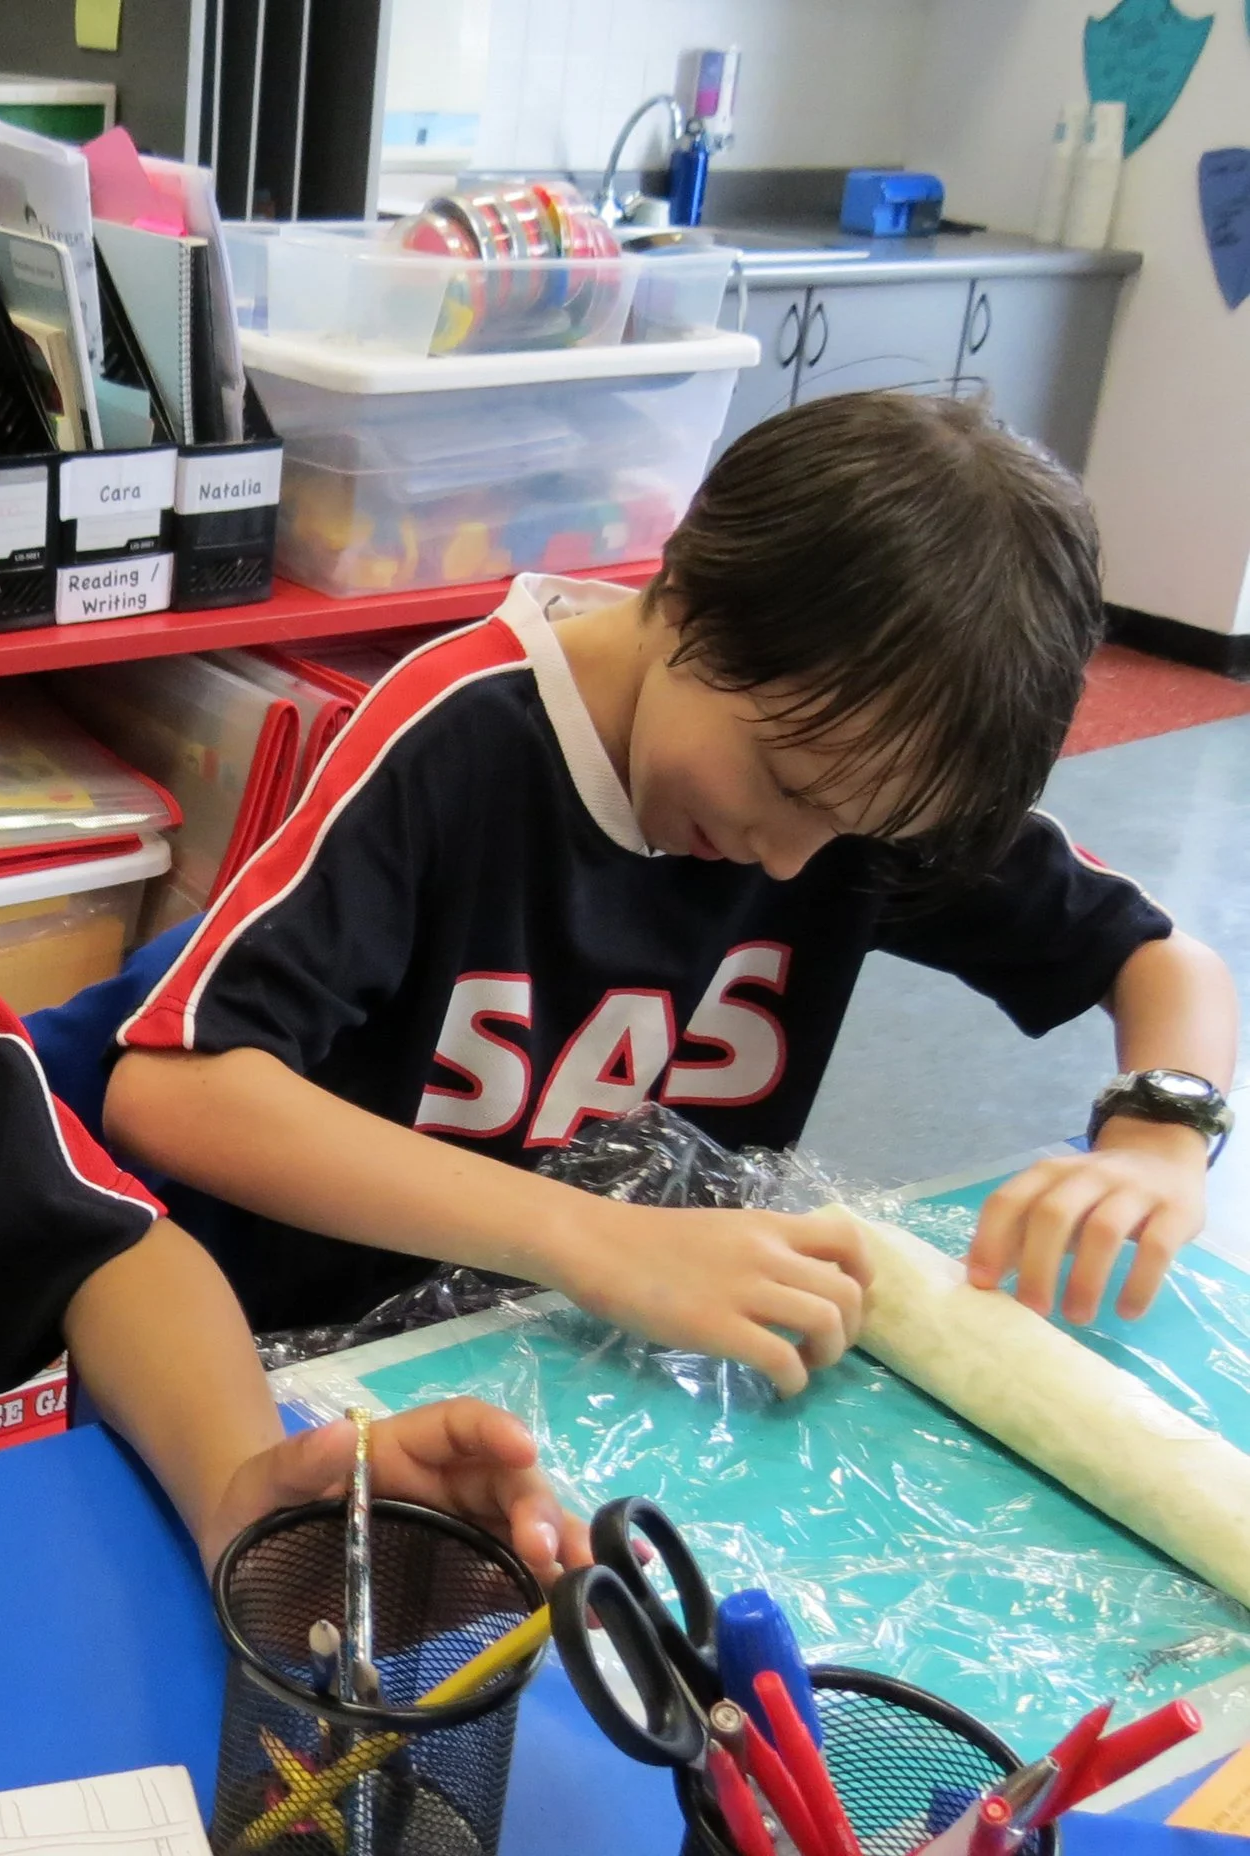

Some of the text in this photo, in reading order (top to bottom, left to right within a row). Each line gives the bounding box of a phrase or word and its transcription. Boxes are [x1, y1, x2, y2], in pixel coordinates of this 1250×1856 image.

[100, 485, 142, 502] Cara
[198, 481, 263, 501] Natalia
[68, 563, 160, 593] Reading /
[82, 591, 148, 616] Writing
[413, 940, 793, 1148] SAS
